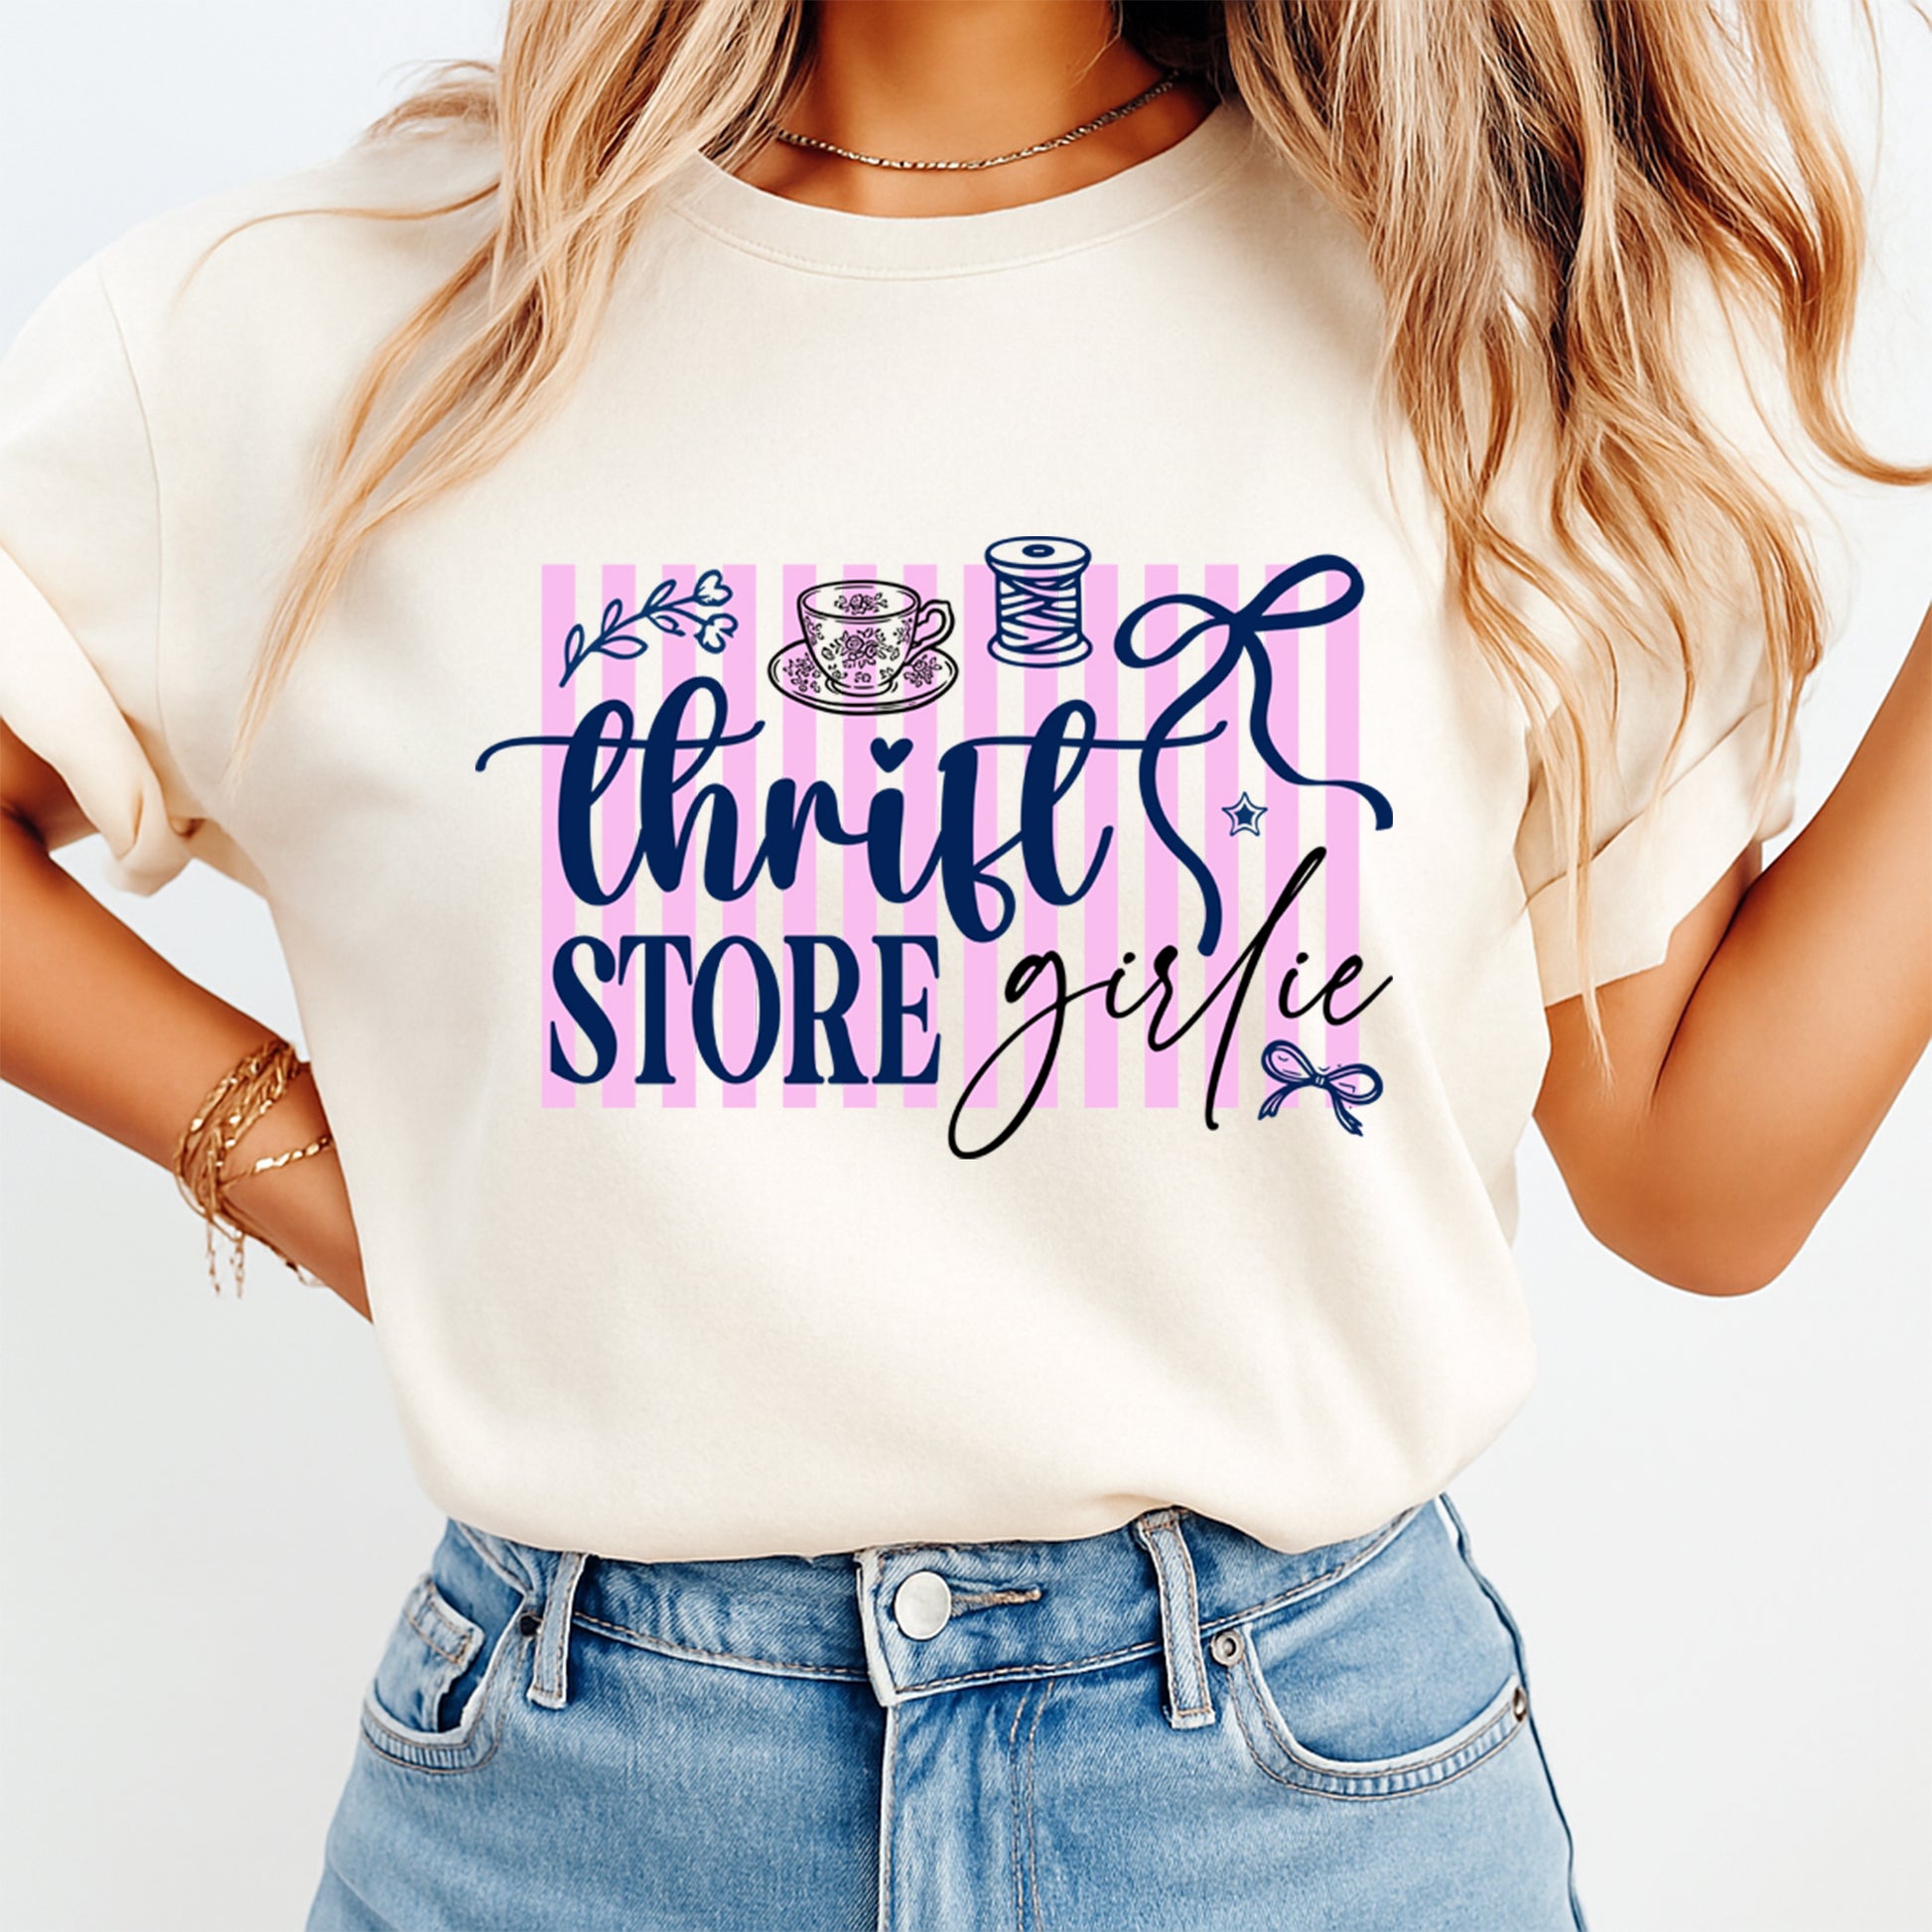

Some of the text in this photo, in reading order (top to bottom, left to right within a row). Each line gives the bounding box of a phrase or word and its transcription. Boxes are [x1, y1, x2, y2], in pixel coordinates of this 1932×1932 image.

[476, 676, 1228, 942] thrift
[550, 847, 1394, 1160] STORE girlie
